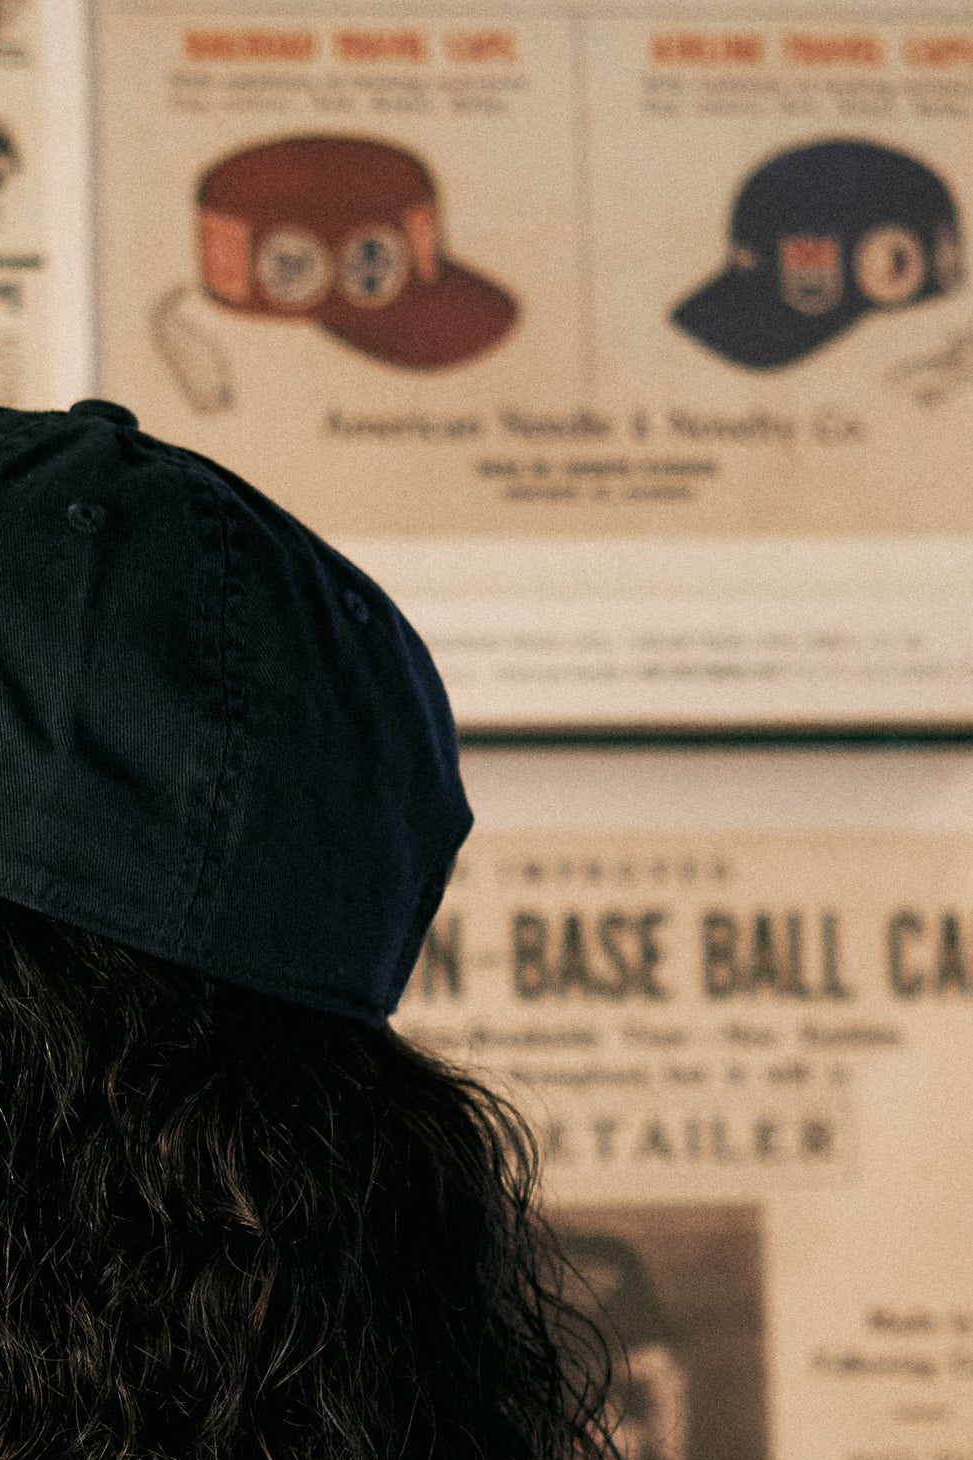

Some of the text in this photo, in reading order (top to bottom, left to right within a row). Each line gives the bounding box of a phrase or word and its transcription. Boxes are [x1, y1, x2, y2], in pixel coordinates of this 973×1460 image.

[323, 409, 487, 442] American
[497, 408, 613, 442] Needle
[667, 409, 797, 446] Novelty
[511, 908, 669, 1002] BASE
[701, 908, 853, 1002] BALL
[886, 908, 973, 1000] CA
[545, 1116, 835, 1166] ETAILER
